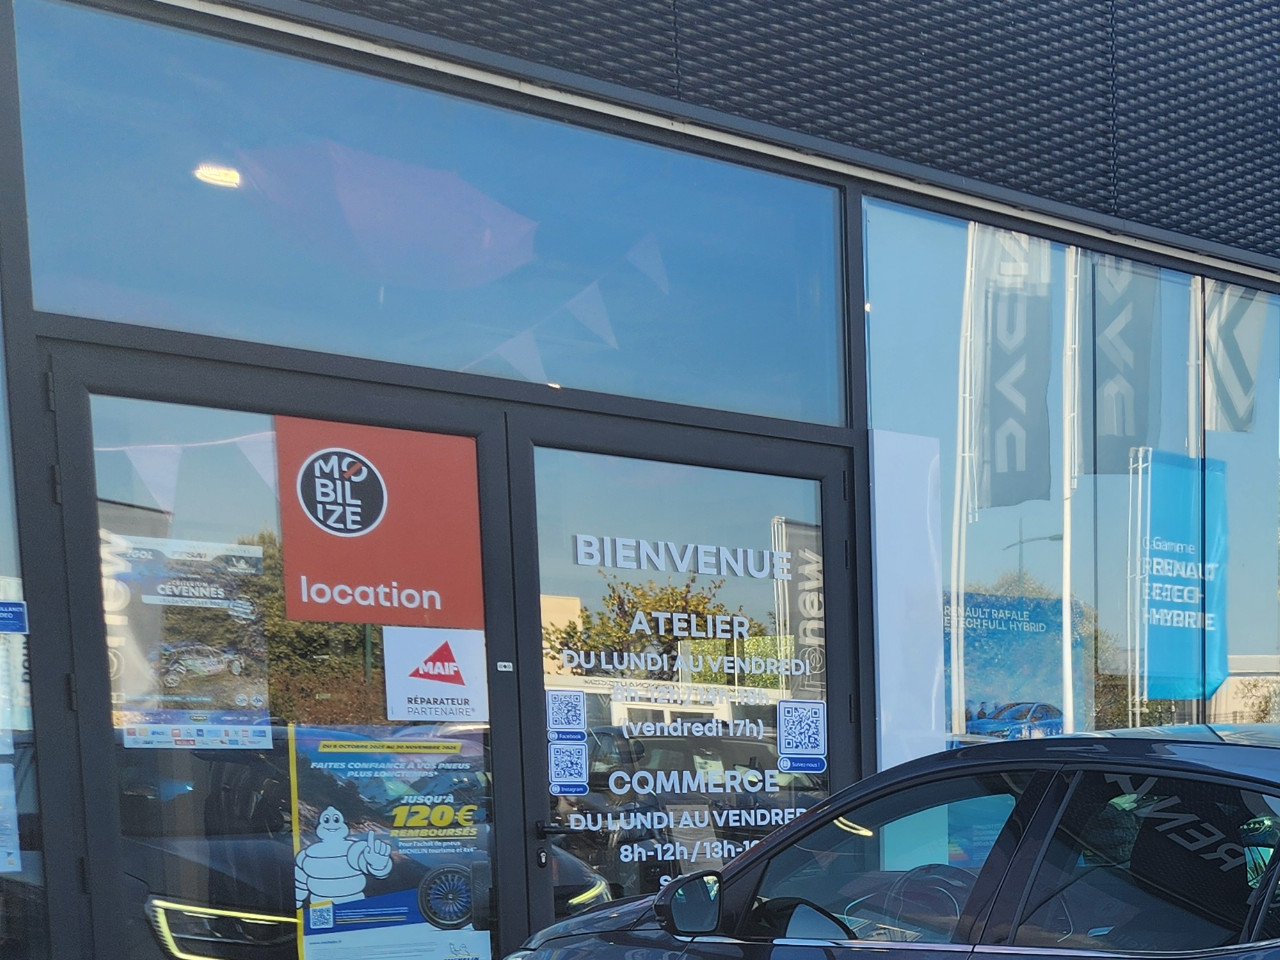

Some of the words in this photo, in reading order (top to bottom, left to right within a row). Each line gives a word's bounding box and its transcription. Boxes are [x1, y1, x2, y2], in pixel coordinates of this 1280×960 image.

[314, 455, 368, 482] MO
[315, 478, 362, 505] BIL
[316, 503, 362, 530] IZE
[576, 533, 792, 581] BIENVENUE
[301, 575, 442, 610] location
[629, 610, 750, 640] ATELIER
[982, 619, 1007, 630] FULL
[1009, 621, 1047, 632] HYBRID
[991, 609, 1029, 621] RAFALE
[418, 661, 459, 675] MAIF
[562, 649, 596, 669] DU
[600, 651, 668, 672] LUNDI
[673, 653, 702, 673] AU
[706, 656, 811, 676] VENDREDI
[407, 695, 470, 706] RÉPARATEUR
[612, 685, 682, 704] 8h-12h
[698, 686, 771, 706] 14h-18h
[621, 716, 723, 739] (vendredi
[727, 718, 765, 740] 17h)
[346, 770, 373, 778] PLUS
[417, 762, 436, 770] VOS
[437, 762, 471, 770] PNEUS
[608, 769, 781, 795] COMMERCE
[400, 793, 455, 806] JUSQU'À
[391, 804, 478, 827] 120€
[569, 814, 602, 832] DU
[606, 811, 674, 831] LUNDI
[678, 811, 709, 829] AU
[389, 827, 479, 838] REMBOURSÉS
[618, 844, 688, 863] 8h-12h
[690, 841, 701, 863] /
